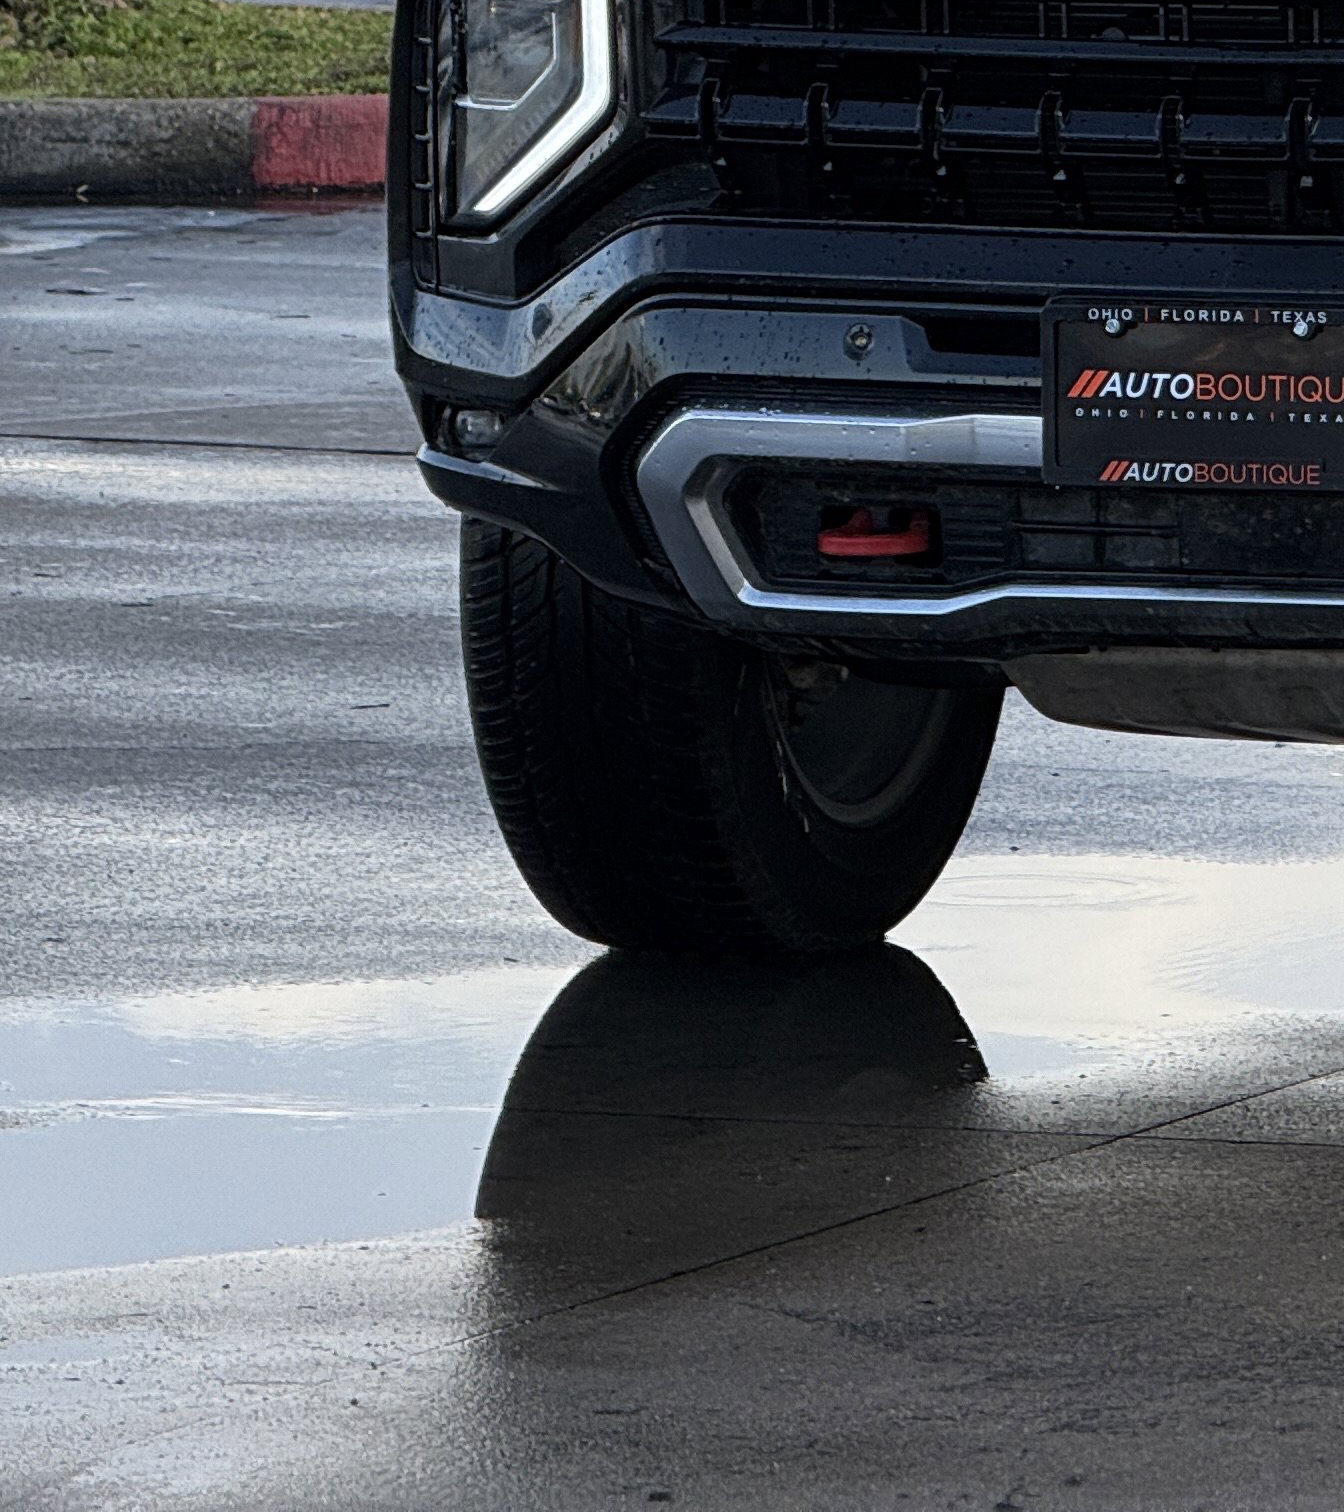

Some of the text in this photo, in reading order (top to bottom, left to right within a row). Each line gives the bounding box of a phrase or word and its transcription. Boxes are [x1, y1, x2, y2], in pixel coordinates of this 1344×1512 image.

[1088, 308, 1328, 324] OHIO FLORIDA TEXAS
[1075, 408, 1128, 418] OHIO
[1157, 410, 1255, 421] FLORIDA
[1122, 462, 1321, 485] AUTOBOUTIQUE
